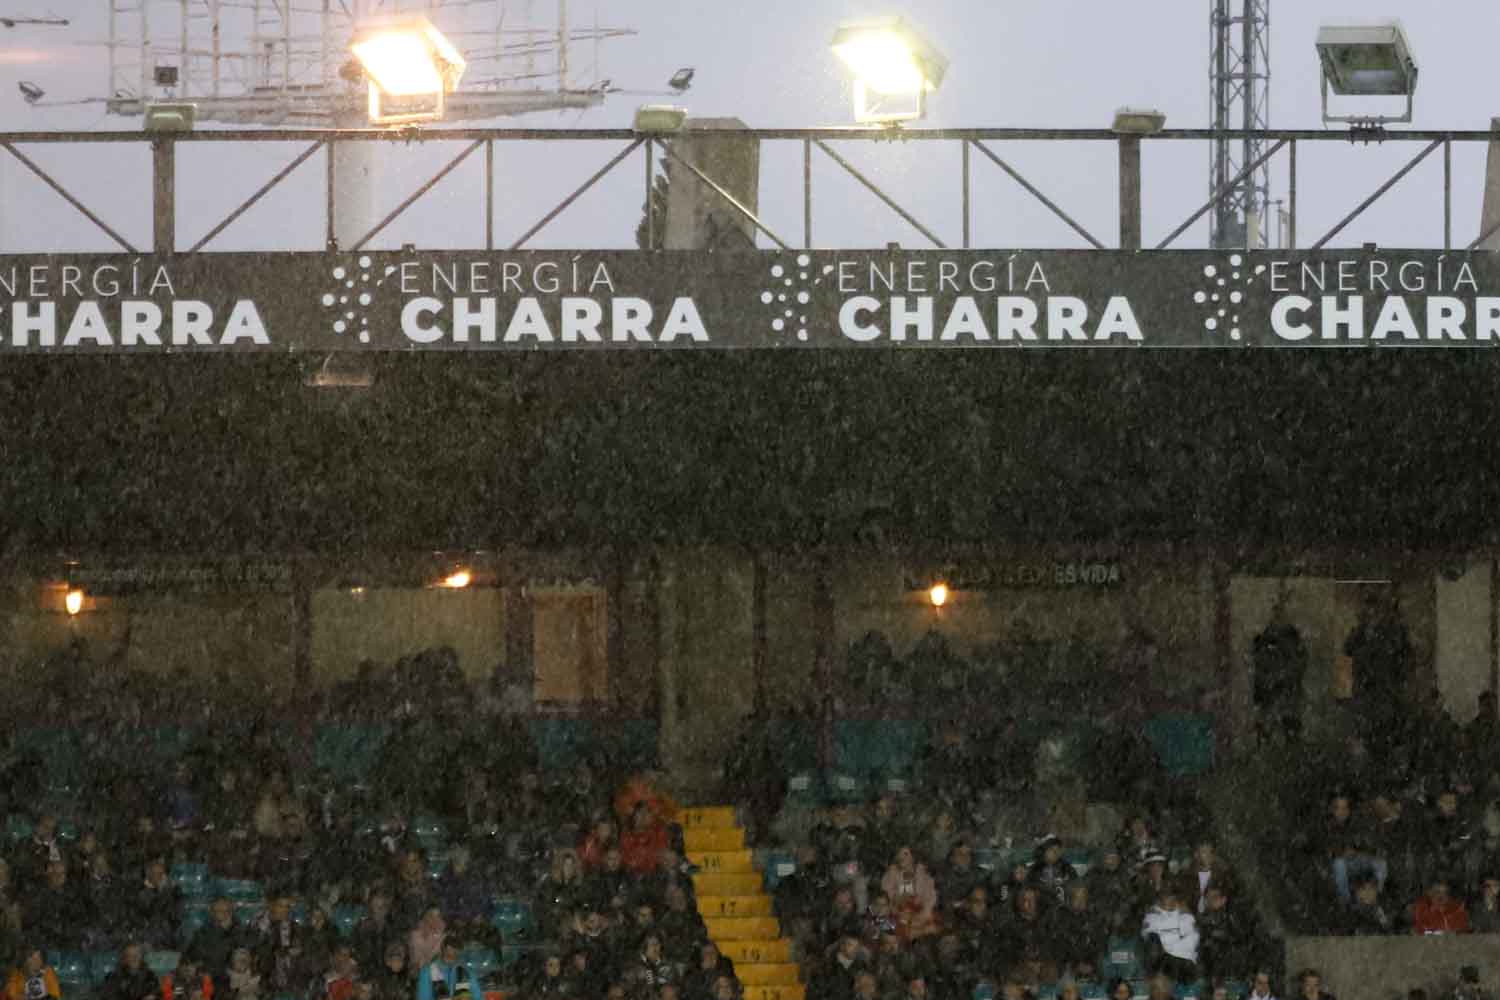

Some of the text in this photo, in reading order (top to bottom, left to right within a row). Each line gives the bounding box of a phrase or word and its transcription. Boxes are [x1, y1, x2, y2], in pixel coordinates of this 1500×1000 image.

[401, 254, 614, 294] ENERGÍA
[838, 254, 1051, 292] ENERGÍA
[1271, 254, 1479, 292] ENERGÍA
[0, 300, 270, 346] HARRA
[401, 297, 710, 342] CHARRA
[838, 296, 1144, 341] CHARRA
